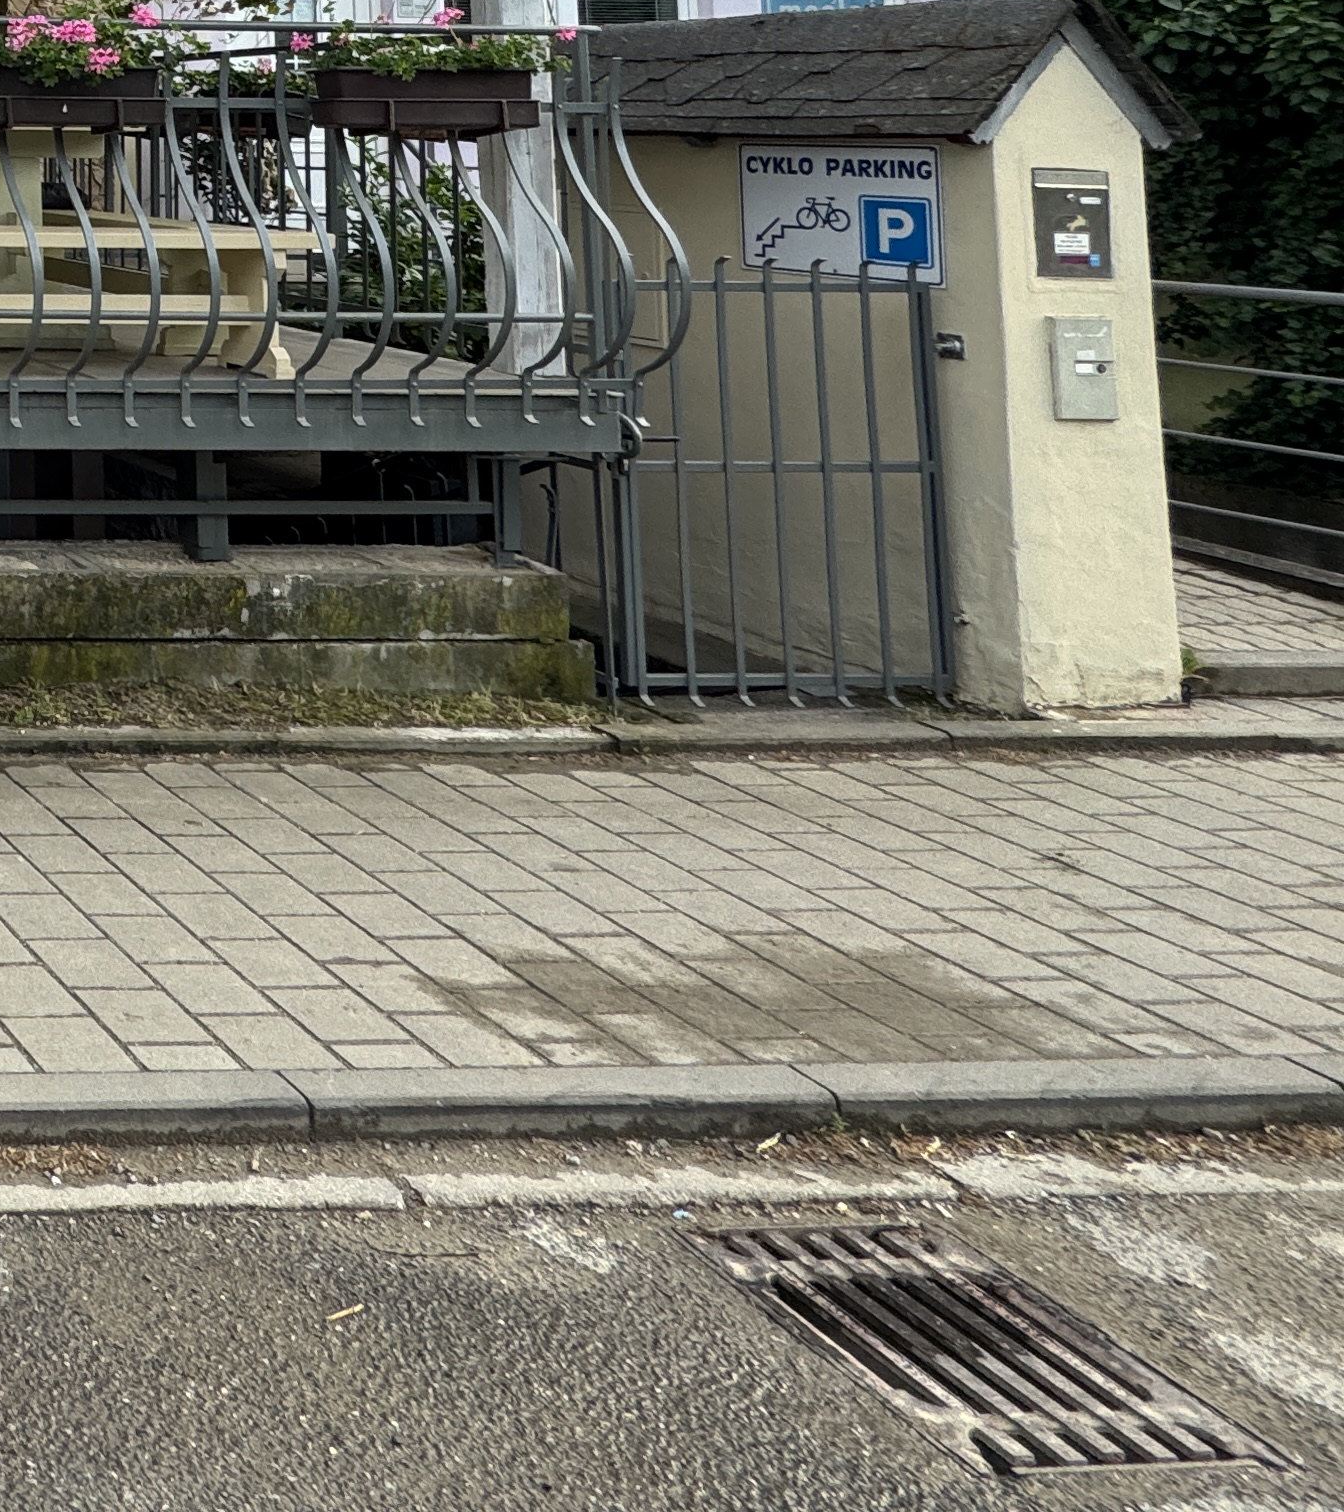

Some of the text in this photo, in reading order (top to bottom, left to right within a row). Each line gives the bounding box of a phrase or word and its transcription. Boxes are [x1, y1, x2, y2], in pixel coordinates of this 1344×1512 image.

[745, 155, 933, 180] CYKLO PARKING
[877, 207, 915, 254] P
